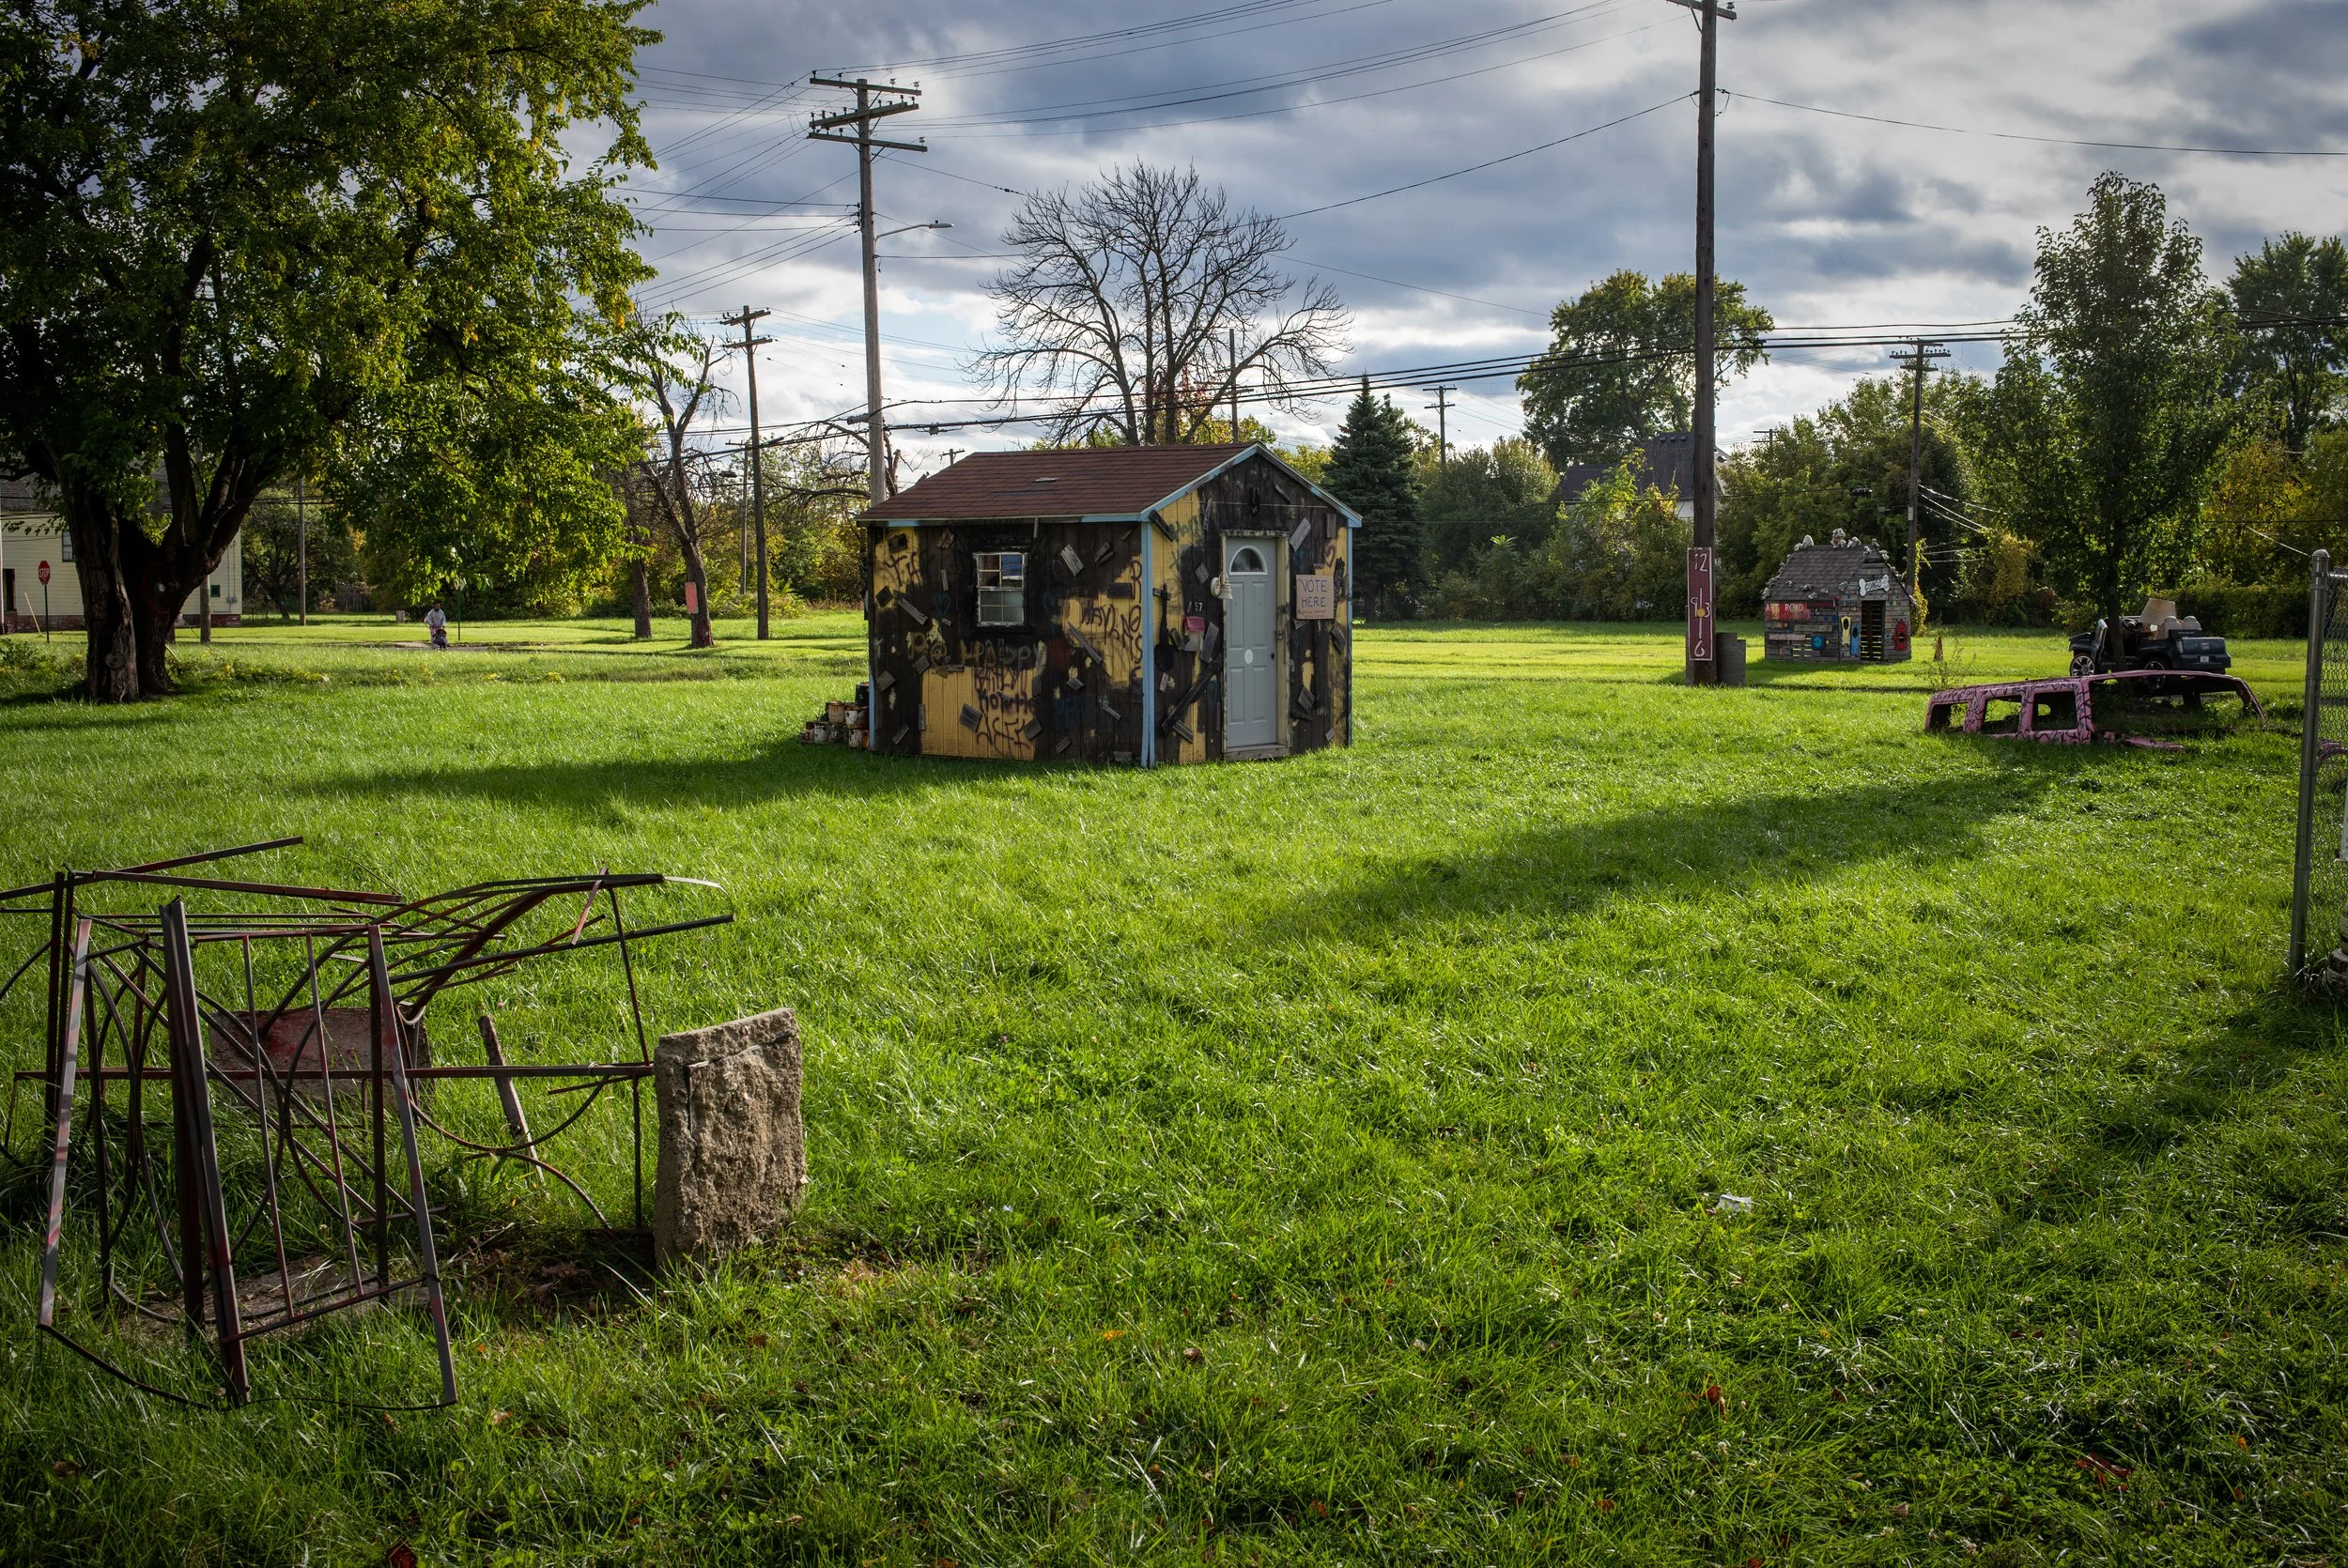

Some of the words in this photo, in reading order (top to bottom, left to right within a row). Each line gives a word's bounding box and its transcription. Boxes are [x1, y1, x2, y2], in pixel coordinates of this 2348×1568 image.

[1694, 553, 1708, 572] 12
[39, 568, 50, 577] STOP
[1301, 579, 1328, 592] VOTE
[1301, 596, 1327, 607] HERE
[1691, 597, 1698, 618] 9
[1766, 603, 1780, 612] ART
[1704, 602, 1710, 618] 3
[1693, 639, 1706, 657] 6
